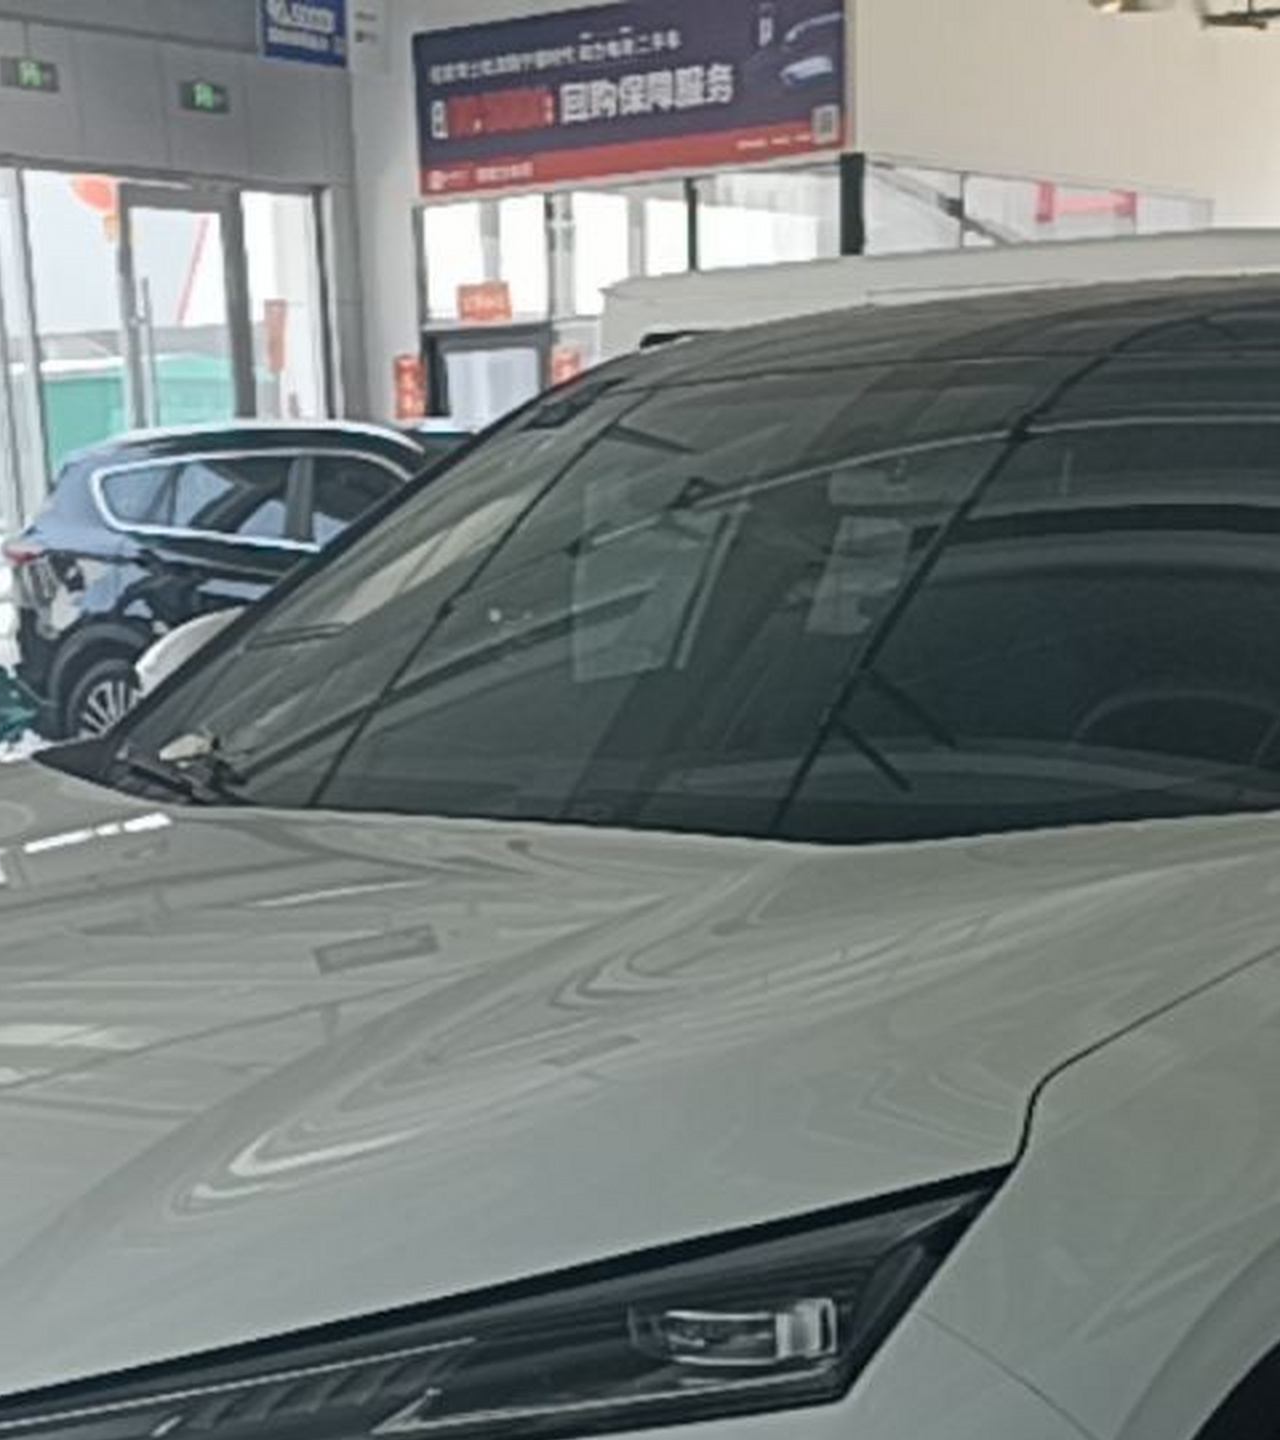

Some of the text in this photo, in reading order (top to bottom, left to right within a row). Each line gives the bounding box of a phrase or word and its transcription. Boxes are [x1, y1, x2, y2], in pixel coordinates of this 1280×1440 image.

[559, 63, 734, 123] 回购保障服务
